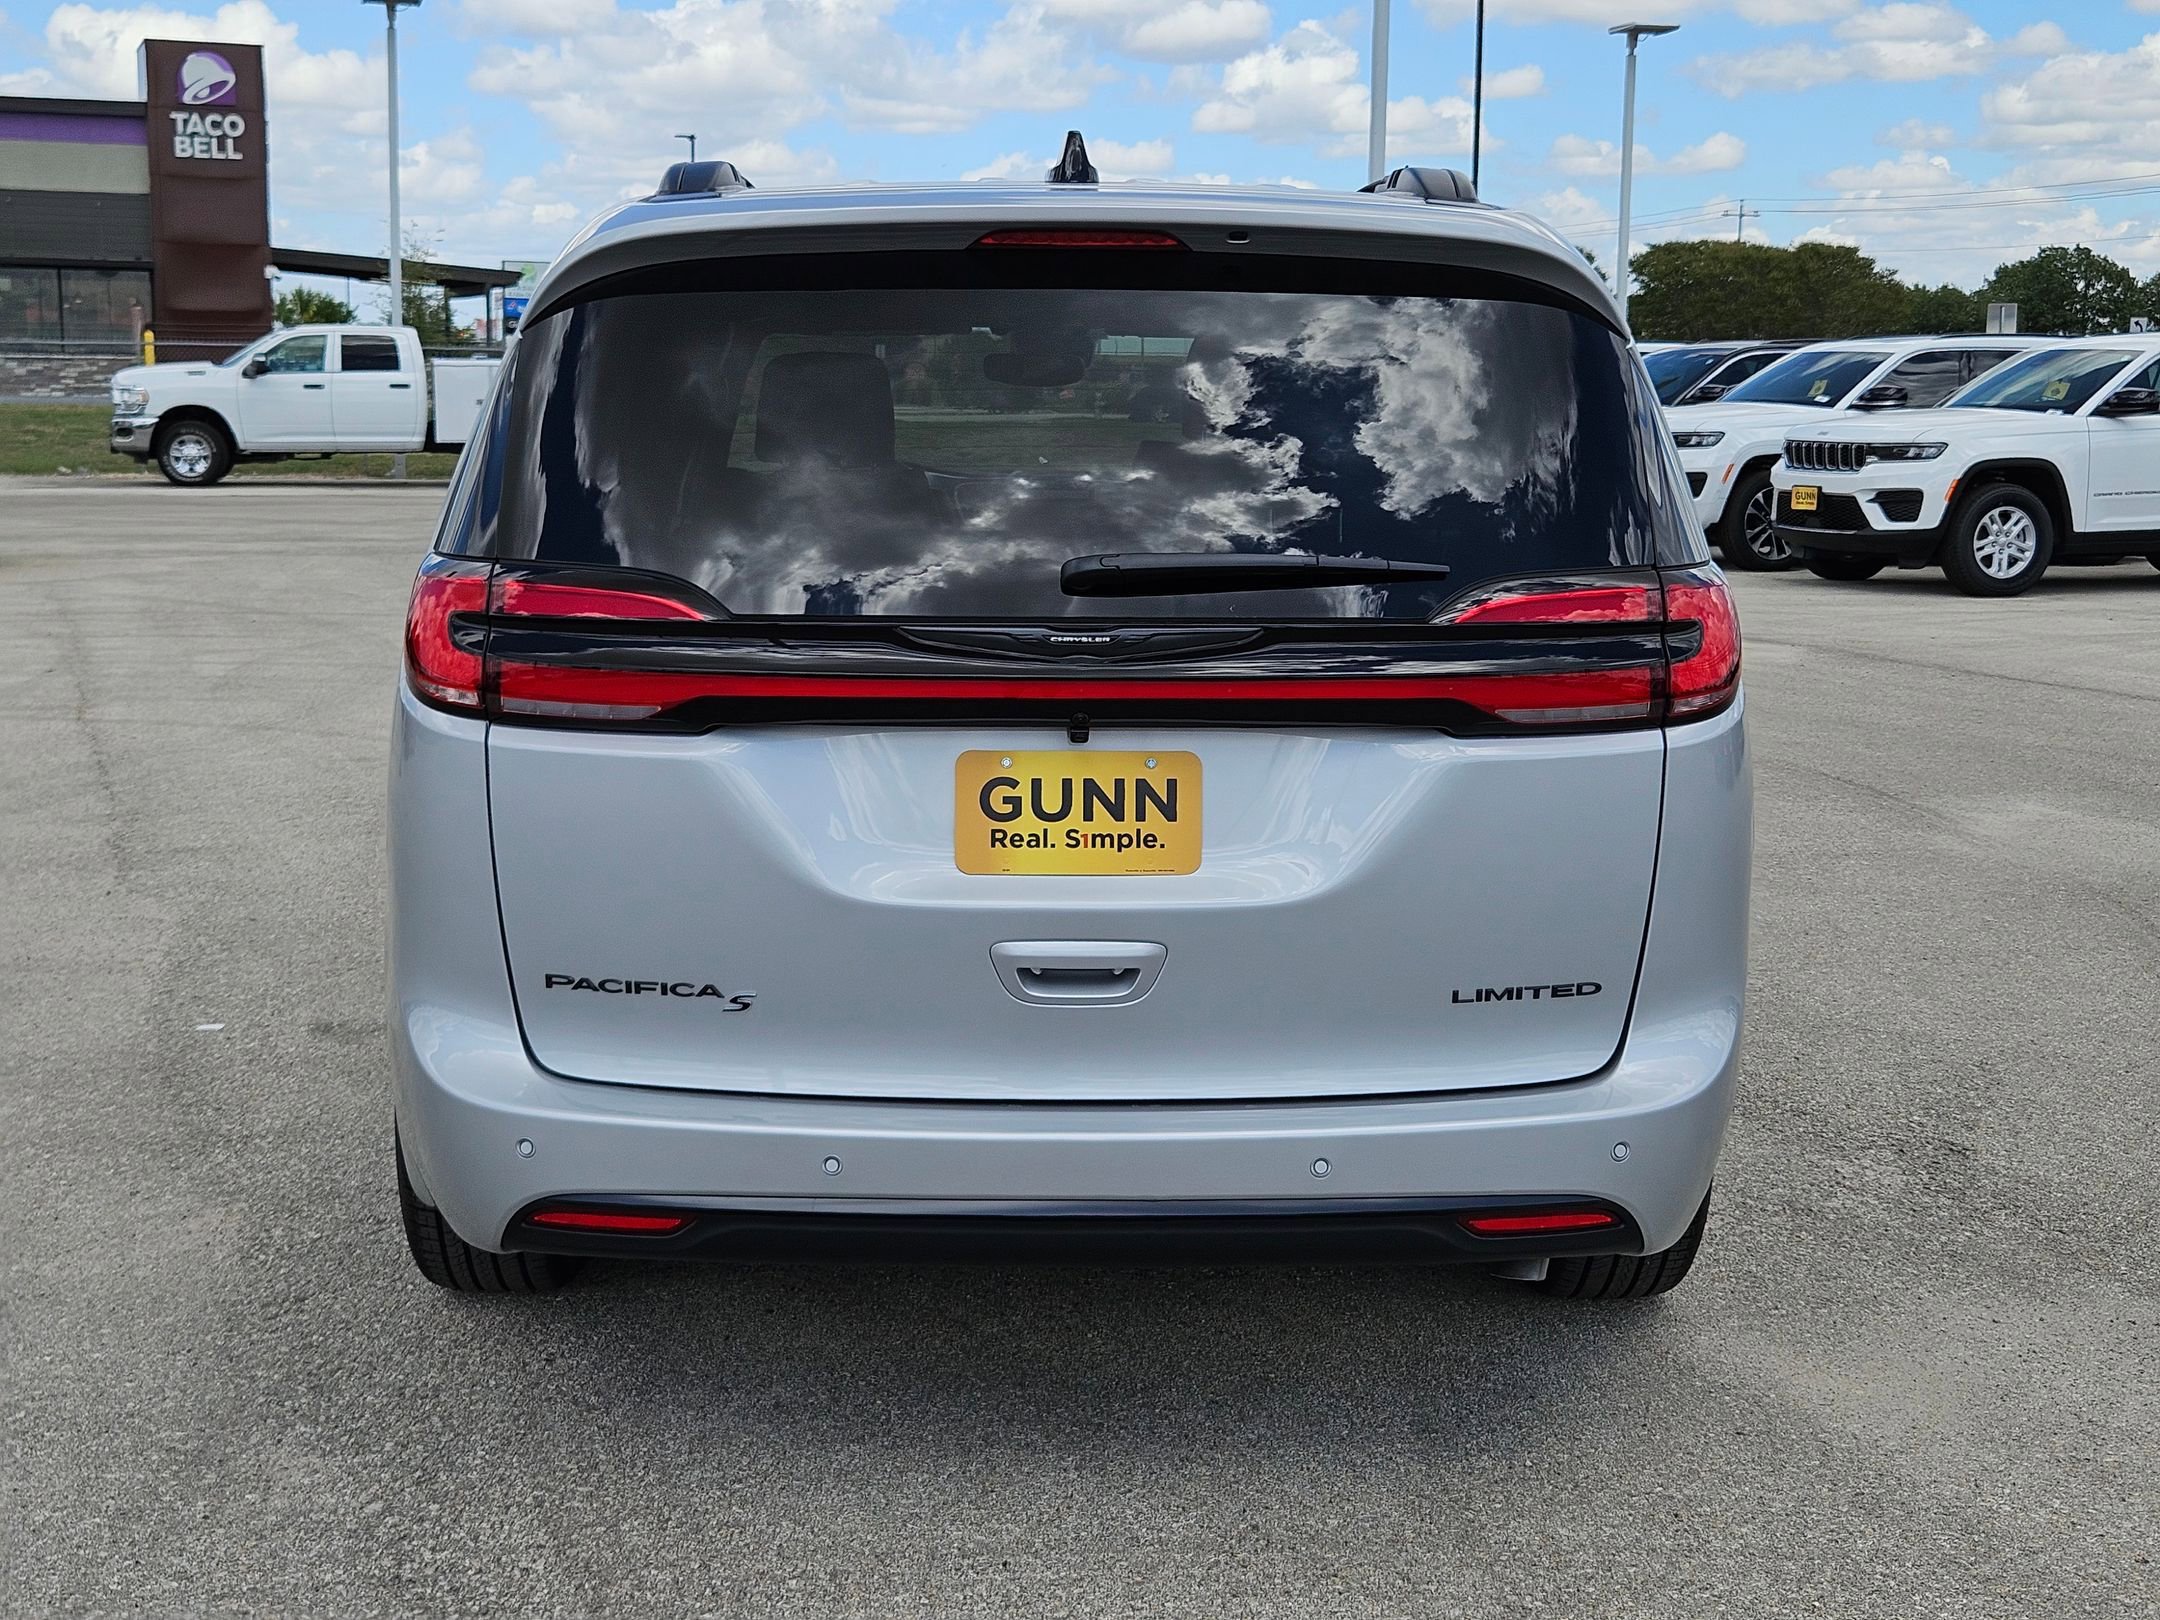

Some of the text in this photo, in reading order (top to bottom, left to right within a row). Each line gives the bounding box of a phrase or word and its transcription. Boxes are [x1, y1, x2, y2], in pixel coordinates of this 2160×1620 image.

[169, 111, 246, 138] TACO
[174, 135, 243, 160] BELL
[1794, 491, 1817, 501] GUNN
[979, 776, 1178, 823] GUNN
[990, 828, 1056, 849] Real.
[544, 973, 758, 1012] PACIFICA S
[1451, 981, 1603, 1004] LIMITED
